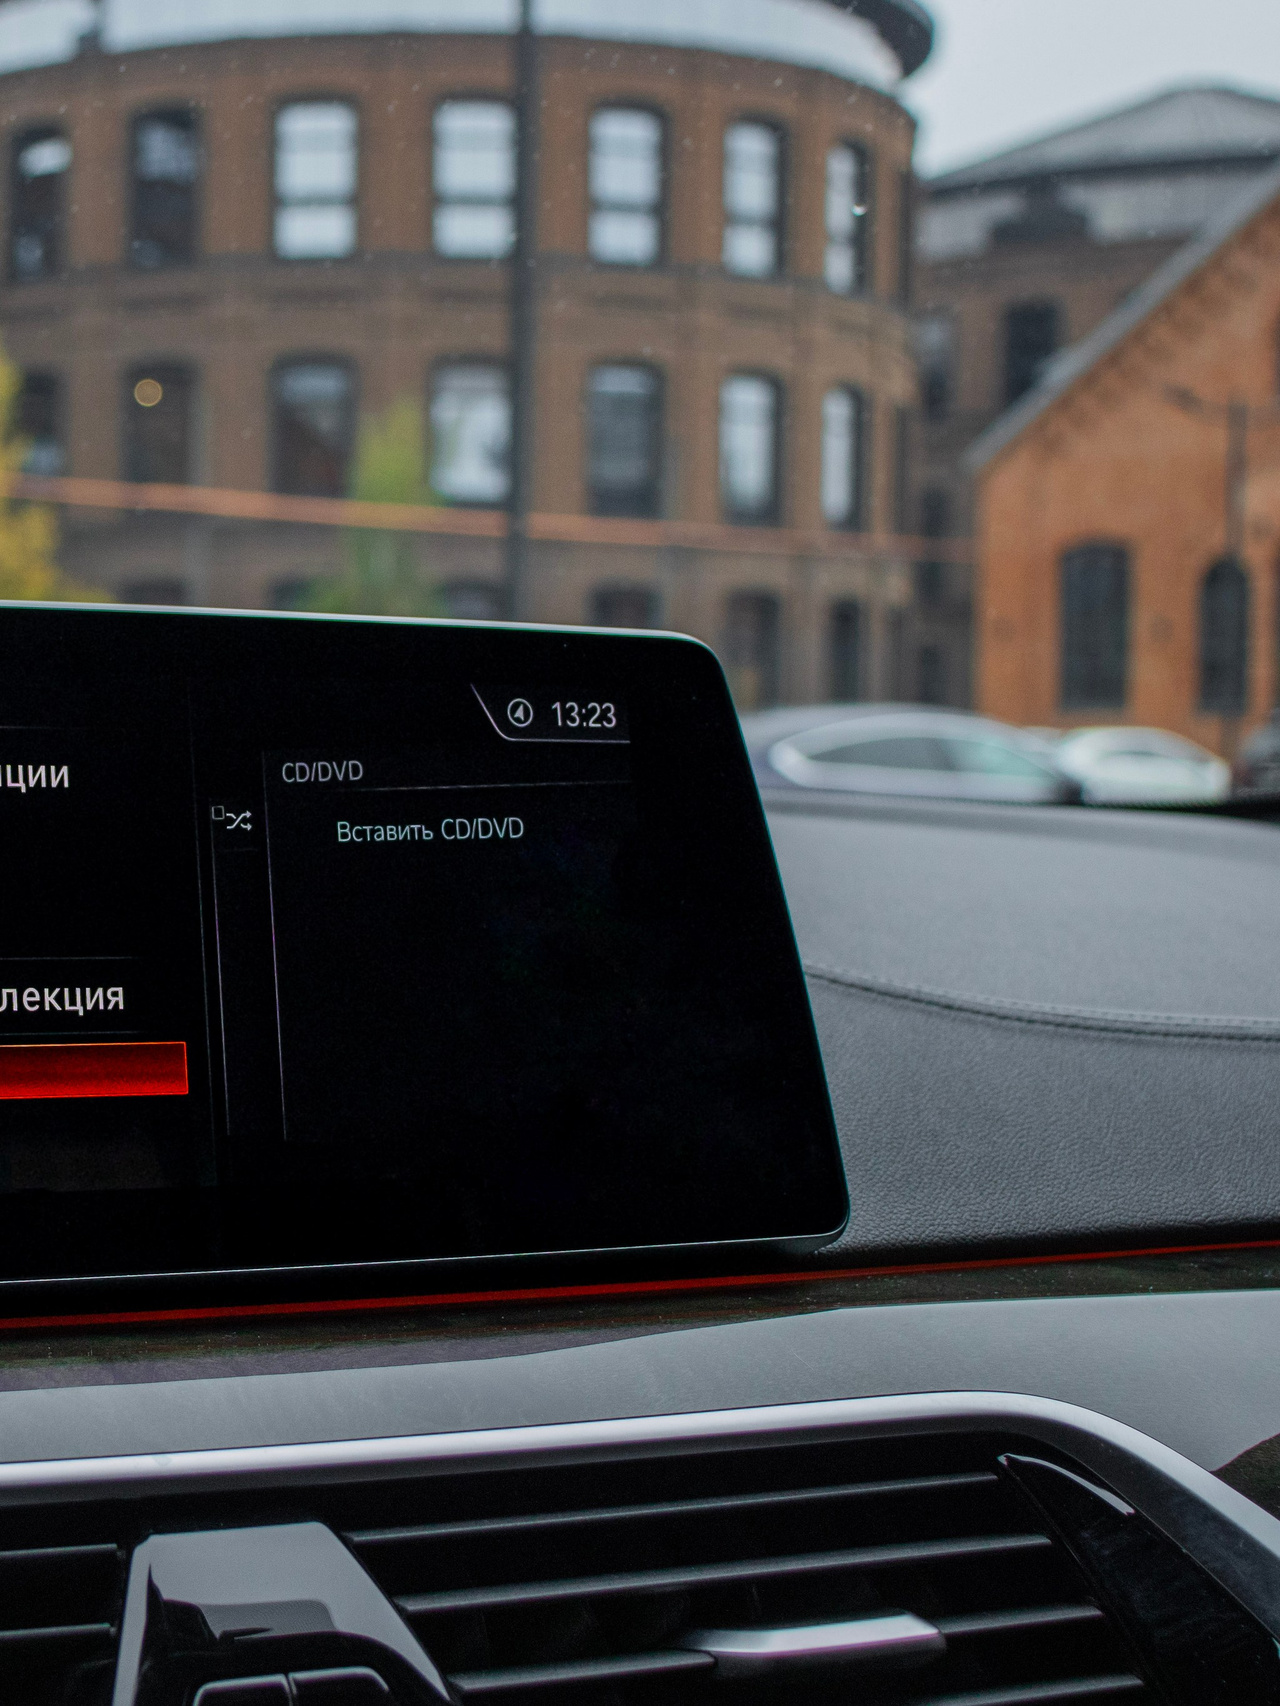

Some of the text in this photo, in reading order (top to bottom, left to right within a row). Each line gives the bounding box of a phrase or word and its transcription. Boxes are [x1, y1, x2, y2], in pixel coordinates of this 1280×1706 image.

[551, 701, 617, 728] 13:23
[281, 760, 363, 783] CD/DVD
[337, 817, 524, 843] Вставить CD/DVD
